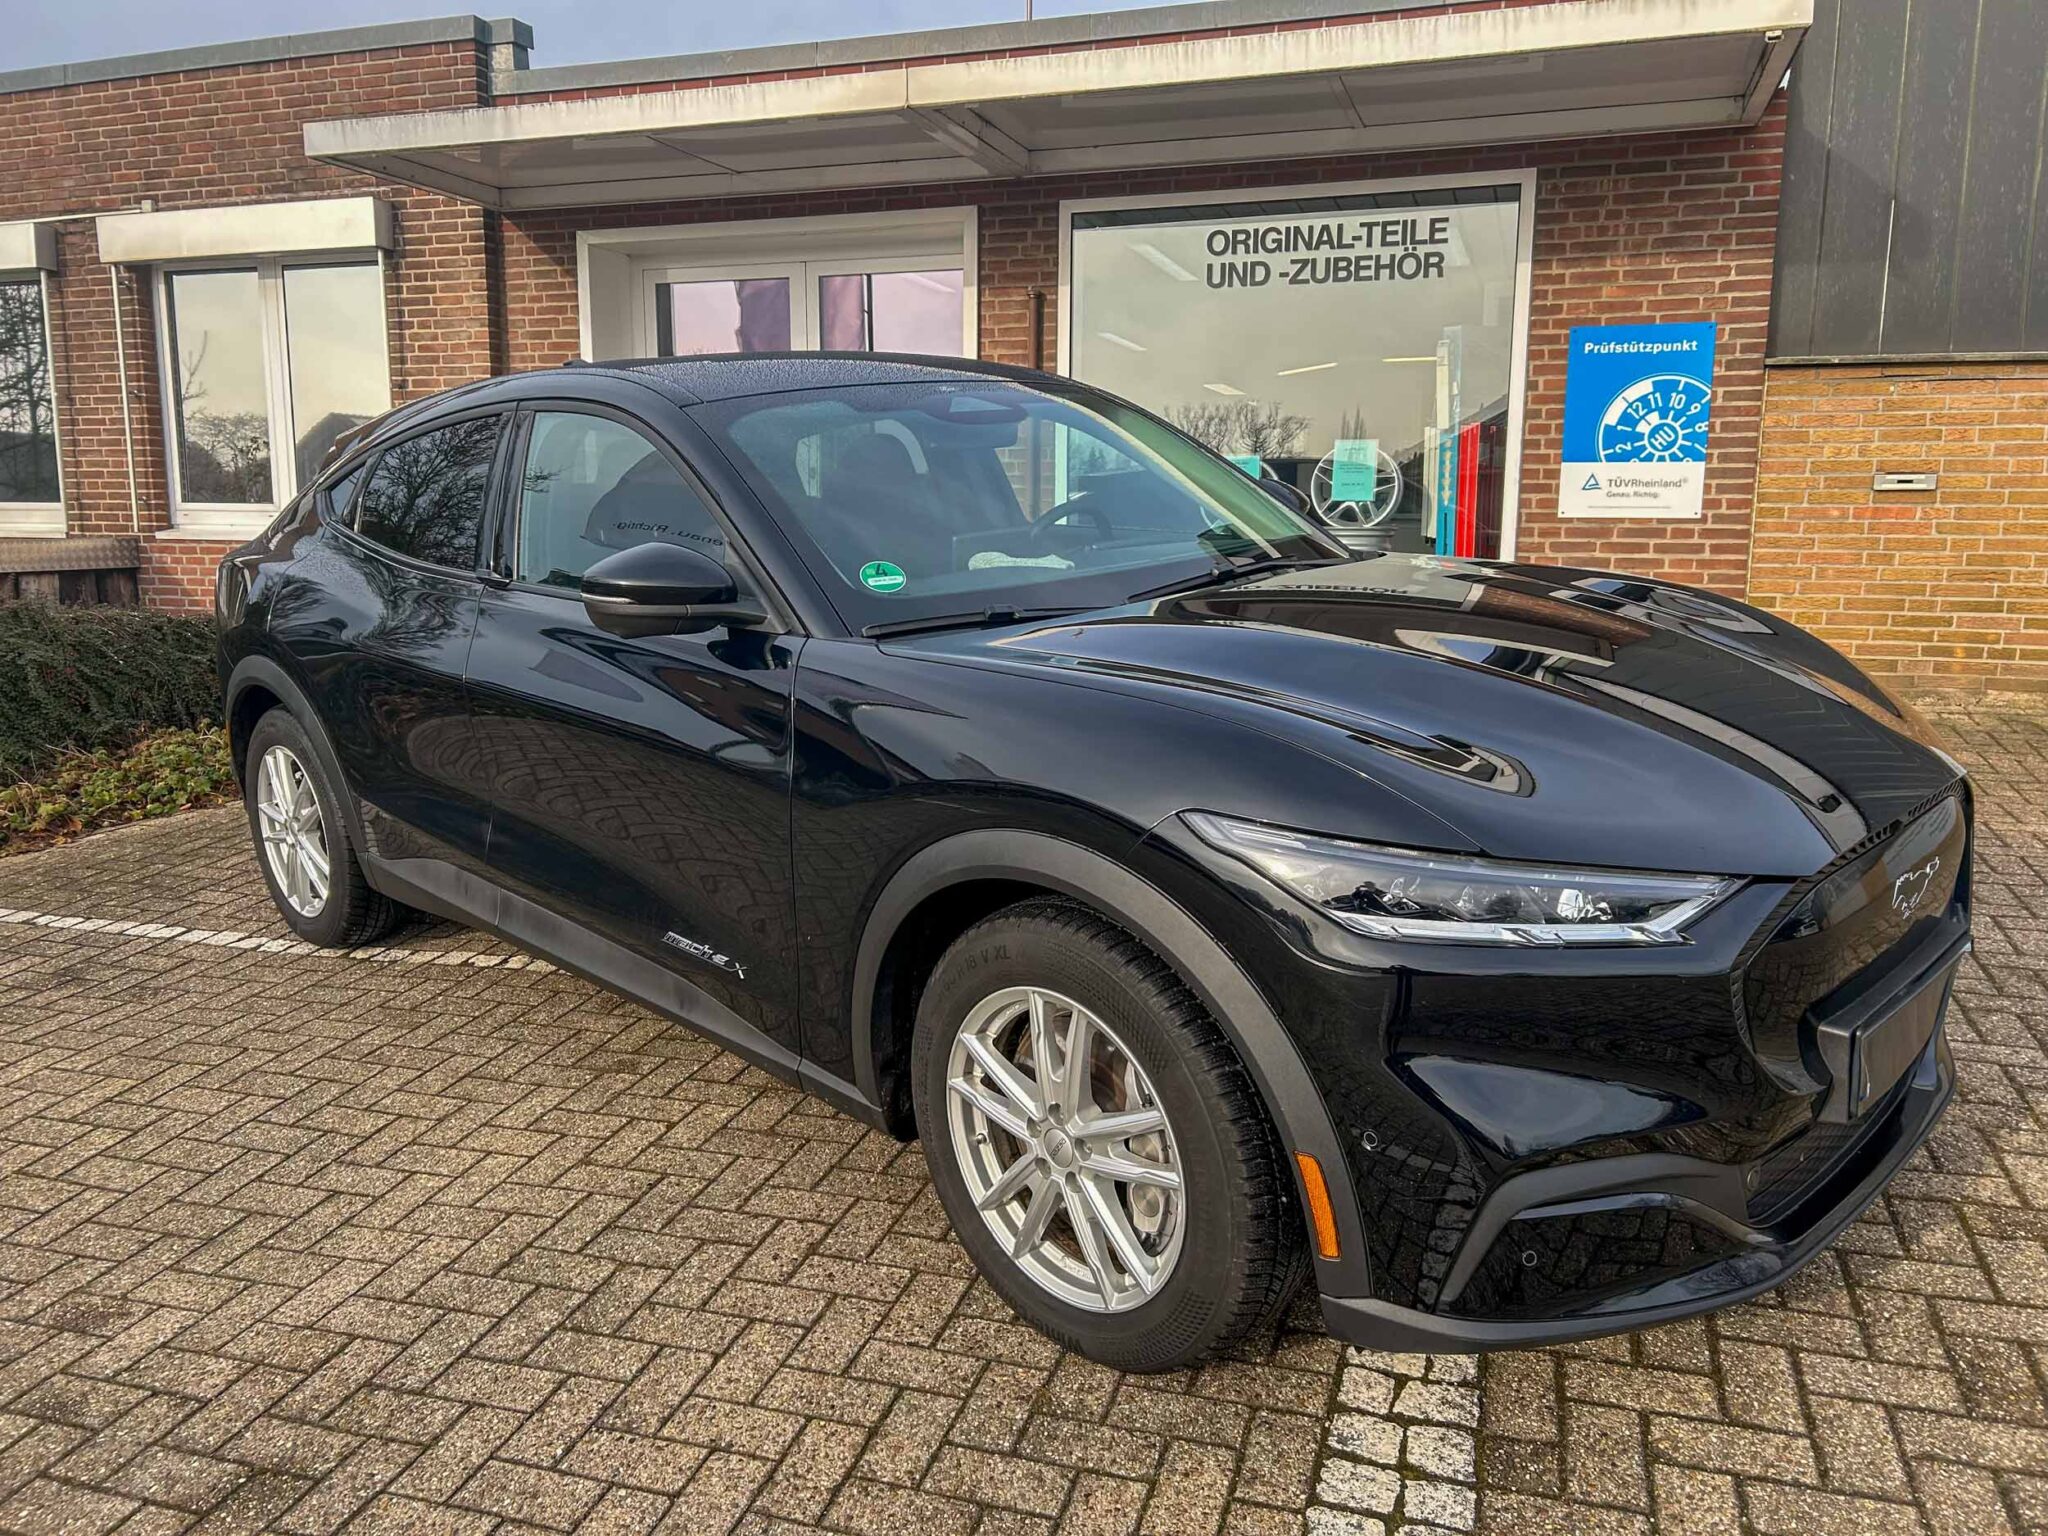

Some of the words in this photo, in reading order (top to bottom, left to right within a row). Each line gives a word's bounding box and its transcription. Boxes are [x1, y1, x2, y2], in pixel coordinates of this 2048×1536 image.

[1207, 217, 1450, 257] ORIGINAL-TEILE
[1206, 261, 1271, 289] UND
[1278, 246, 1445, 286] -ZUBEHÖR
[1585, 340, 1698, 355] Prüfstützpunkt
[1647, 392, 1663, 409] 11
[1669, 391, 1686, 410] 10
[1686, 402, 1702, 415] 9
[1627, 401, 1648, 420] 12
[1651, 426, 1675, 450] HU
[1615, 442, 1632, 453] 2
[875, 563, 888, 577] 4
[994, 944, 1011, 960] XL
